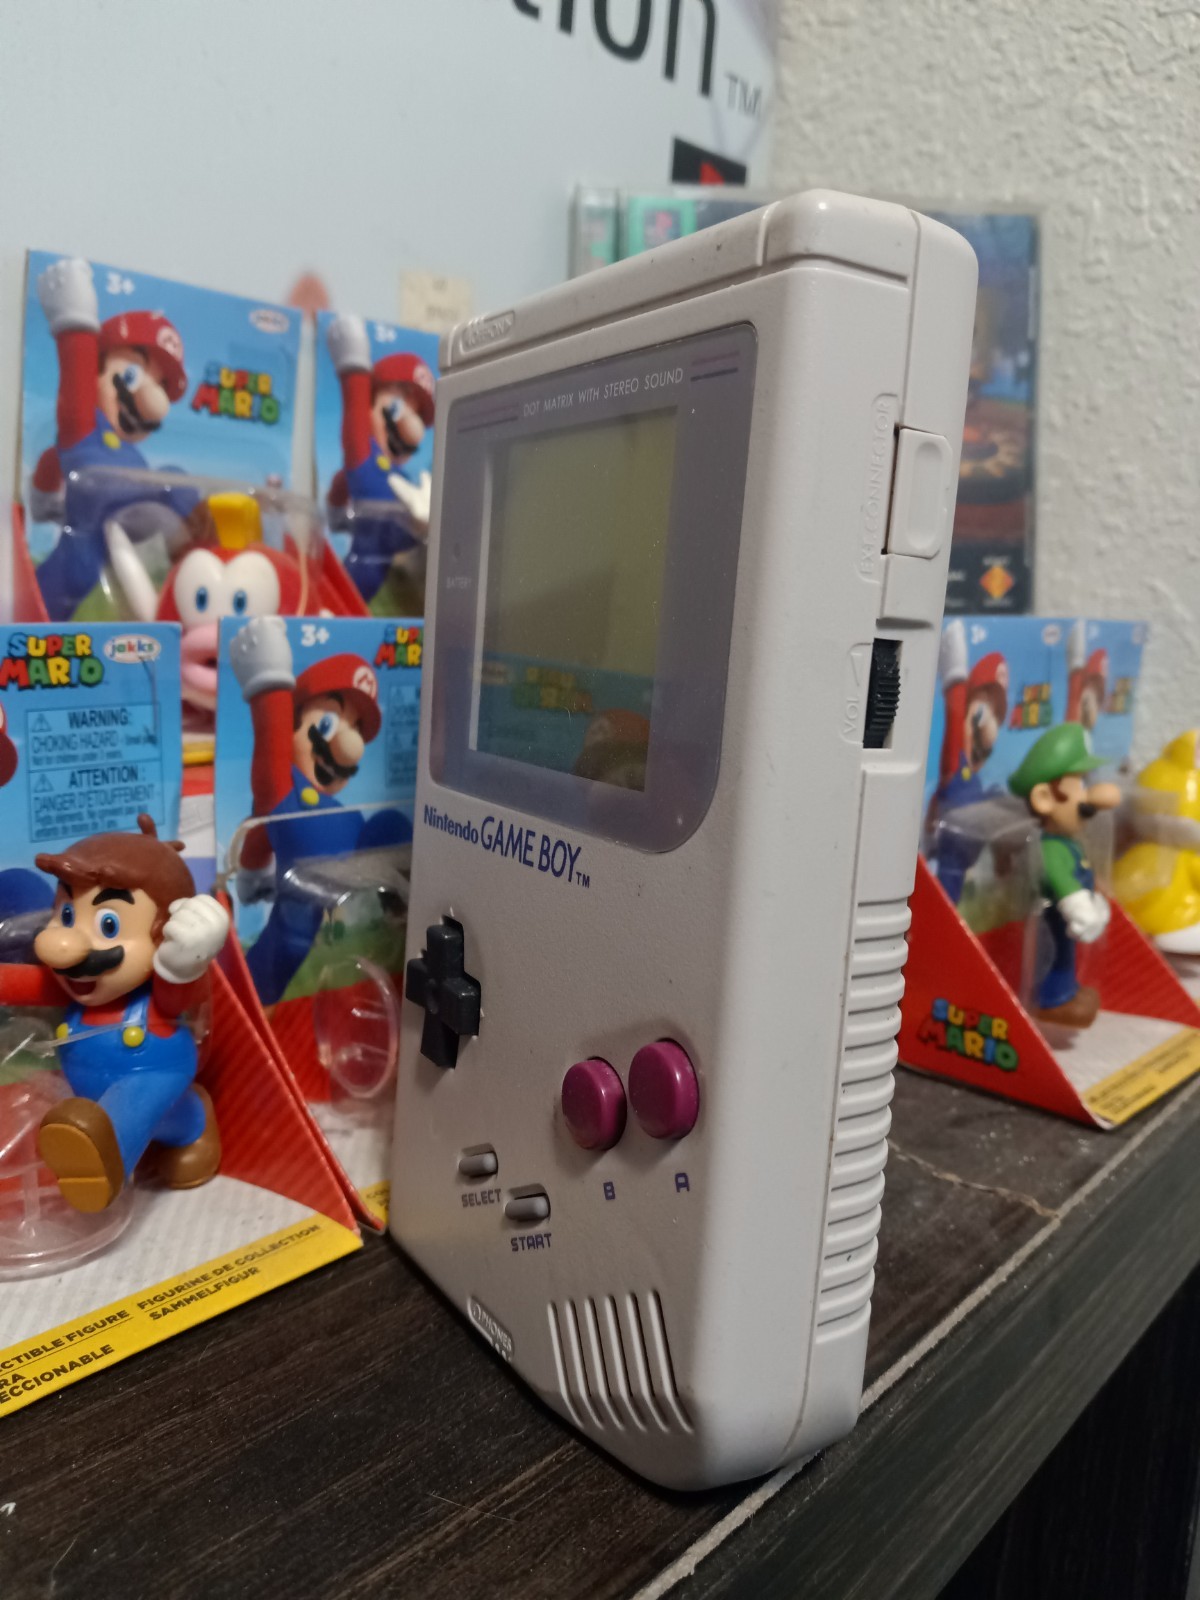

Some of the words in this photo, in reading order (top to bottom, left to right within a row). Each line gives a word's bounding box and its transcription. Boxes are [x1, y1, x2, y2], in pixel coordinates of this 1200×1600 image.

[106, 272, 135, 296] 3+
[523, 401, 541, 417] DOT
[543, 393, 574, 412] MATRIX
[578, 387, 600, 403] WITH
[603, 378, 639, 399] STEREO
[644, 367, 684, 390] SOUND
[8, 632, 92, 658] SUPER
[301, 624, 330, 647] 3+
[384, 625, 423, 645] SUP
[0, 656, 105, 691] MARIO
[423, 805, 479, 844] Nintendo
[480, 816, 536, 867] GAME
[538, 835, 582, 882] BOY
[932, 997, 1008, 1041] SUPER
[917, 1017, 1019, 1073] MARIO
[603, 1182, 616, 1200] B
[674, 1172, 690, 1193] A
[461, 1188, 501, 1208] SELECT
[510, 1233, 552, 1251] START
[137, 1274, 211, 1310] FIGURINE
[212, 1264, 234, 1277] DE
[234, 1224, 321, 1267] COLLECTION
[149, 1266, 261, 1320] SAMMELFIGUR
[0, 1338, 65, 1372] CTIBLE
[65, 1310, 130, 1342] FIGURE
